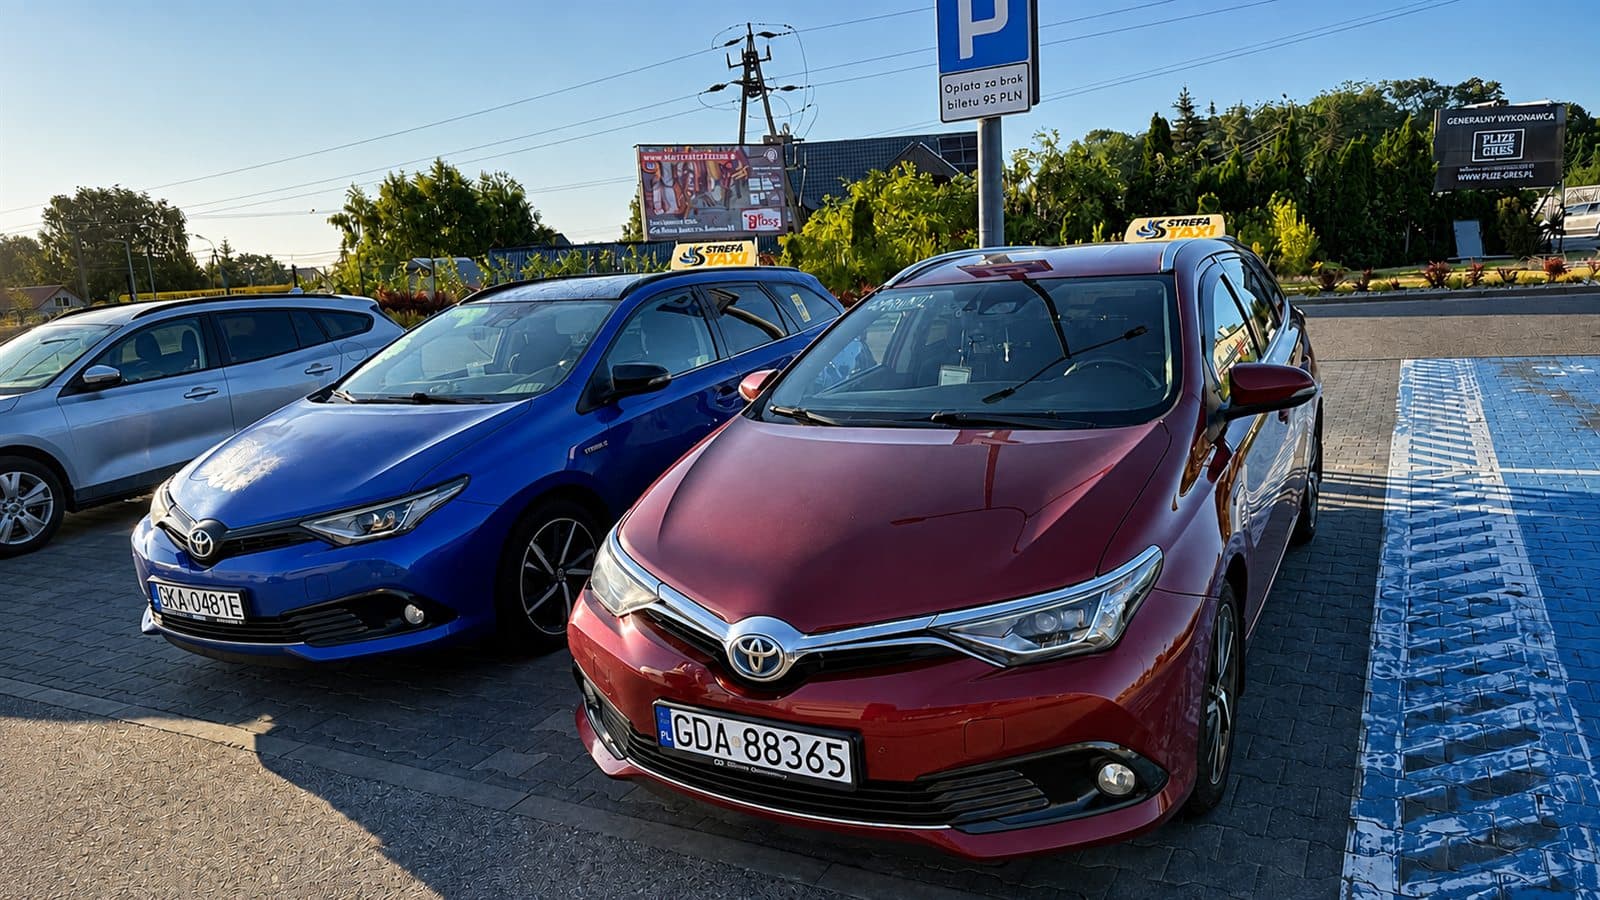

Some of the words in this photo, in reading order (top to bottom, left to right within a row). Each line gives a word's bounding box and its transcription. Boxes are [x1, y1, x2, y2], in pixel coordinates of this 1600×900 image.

[958, 0, 1008, 60] P
[985, 80, 996, 88] za
[1000, 74, 1023, 86] brak
[947, 97, 979, 110] biletu
[983, 94, 996, 105] 95
[1000, 90, 1023, 103] PLN
[1447, 115, 1496, 125] GENERALNY
[1498, 112, 1555, 123] WYKONAWCA
[1483, 133, 1515, 144] PLIZE
[1167, 217, 1211, 226] STREFA
[1168, 226, 1215, 239] TAXI
[705, 243, 743, 254] STREFA
[706, 253, 748, 266] TAXI
[158, 586, 189, 611] GKA
[190, 592, 241, 617] 0481E
[673, 714, 732, 756] GDA
[743, 727, 846, 778] 88365
